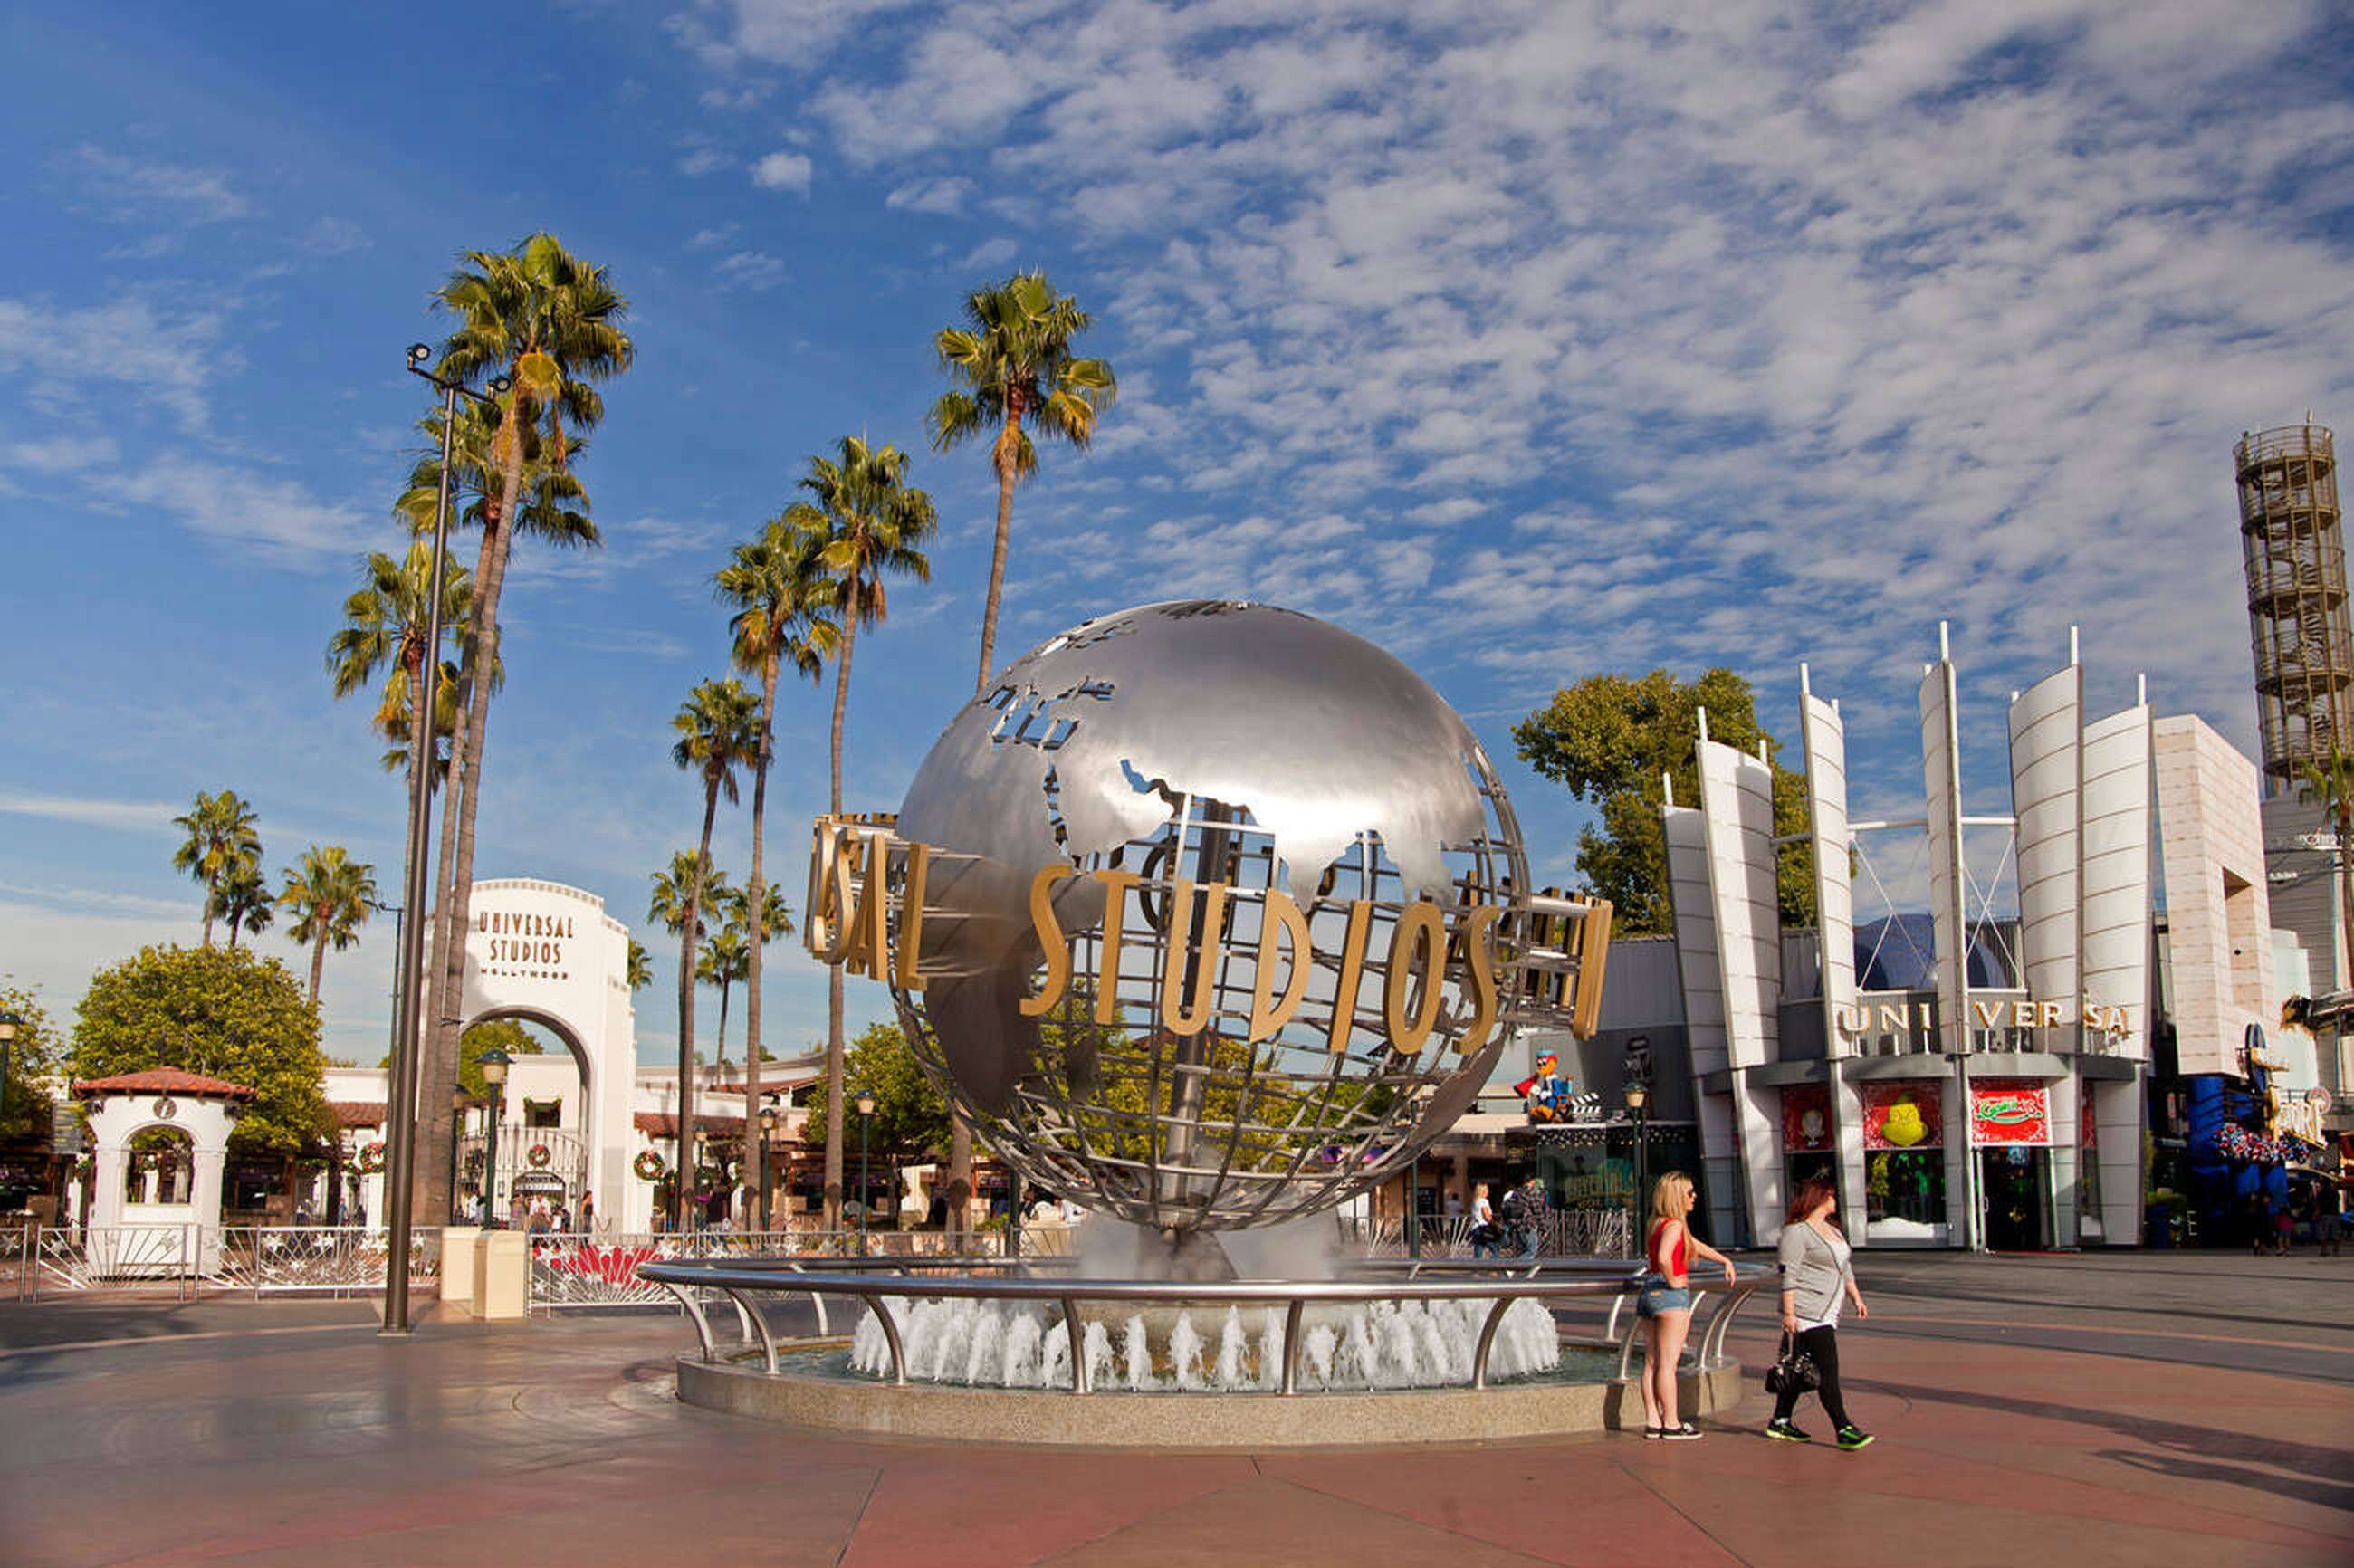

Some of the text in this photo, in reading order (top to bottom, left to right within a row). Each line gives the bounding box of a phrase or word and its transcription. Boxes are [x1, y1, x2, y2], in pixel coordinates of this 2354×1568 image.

[479, 912, 573, 939] UNIVERSAL
[490, 939, 560, 964] STUDIOS
[1020, 863, 1500, 1056] STUDIOS
